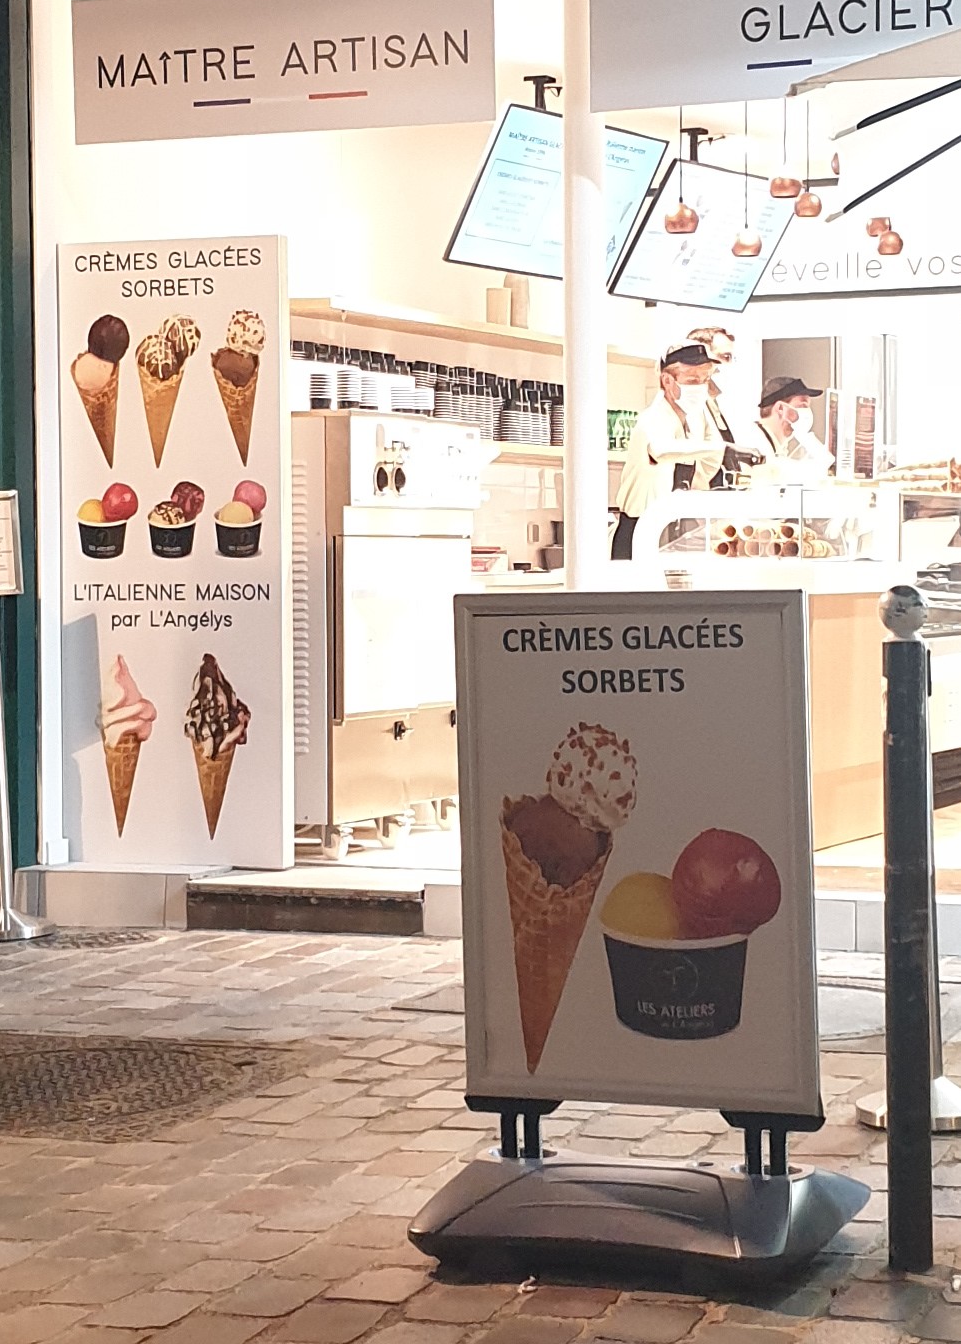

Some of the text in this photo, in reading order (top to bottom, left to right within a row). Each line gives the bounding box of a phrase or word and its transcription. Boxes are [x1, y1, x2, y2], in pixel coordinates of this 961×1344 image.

[97, 29, 470, 90] MAÎTRE ARTISAN
[74, 245, 262, 273] CRÈMES GLACÉES
[906, 254, 961, 276] vos
[121, 277, 215, 298] SORBETS
[73, 583, 270, 602] L'ITALIENNE MAISON
[111, 610, 233, 631] par L'Angélys
[502, 618, 744, 652] CRÈMES GLACÉES
[561, 668, 685, 693] SORBETS
[637, 1000, 716, 1018] LES ATELIERS
